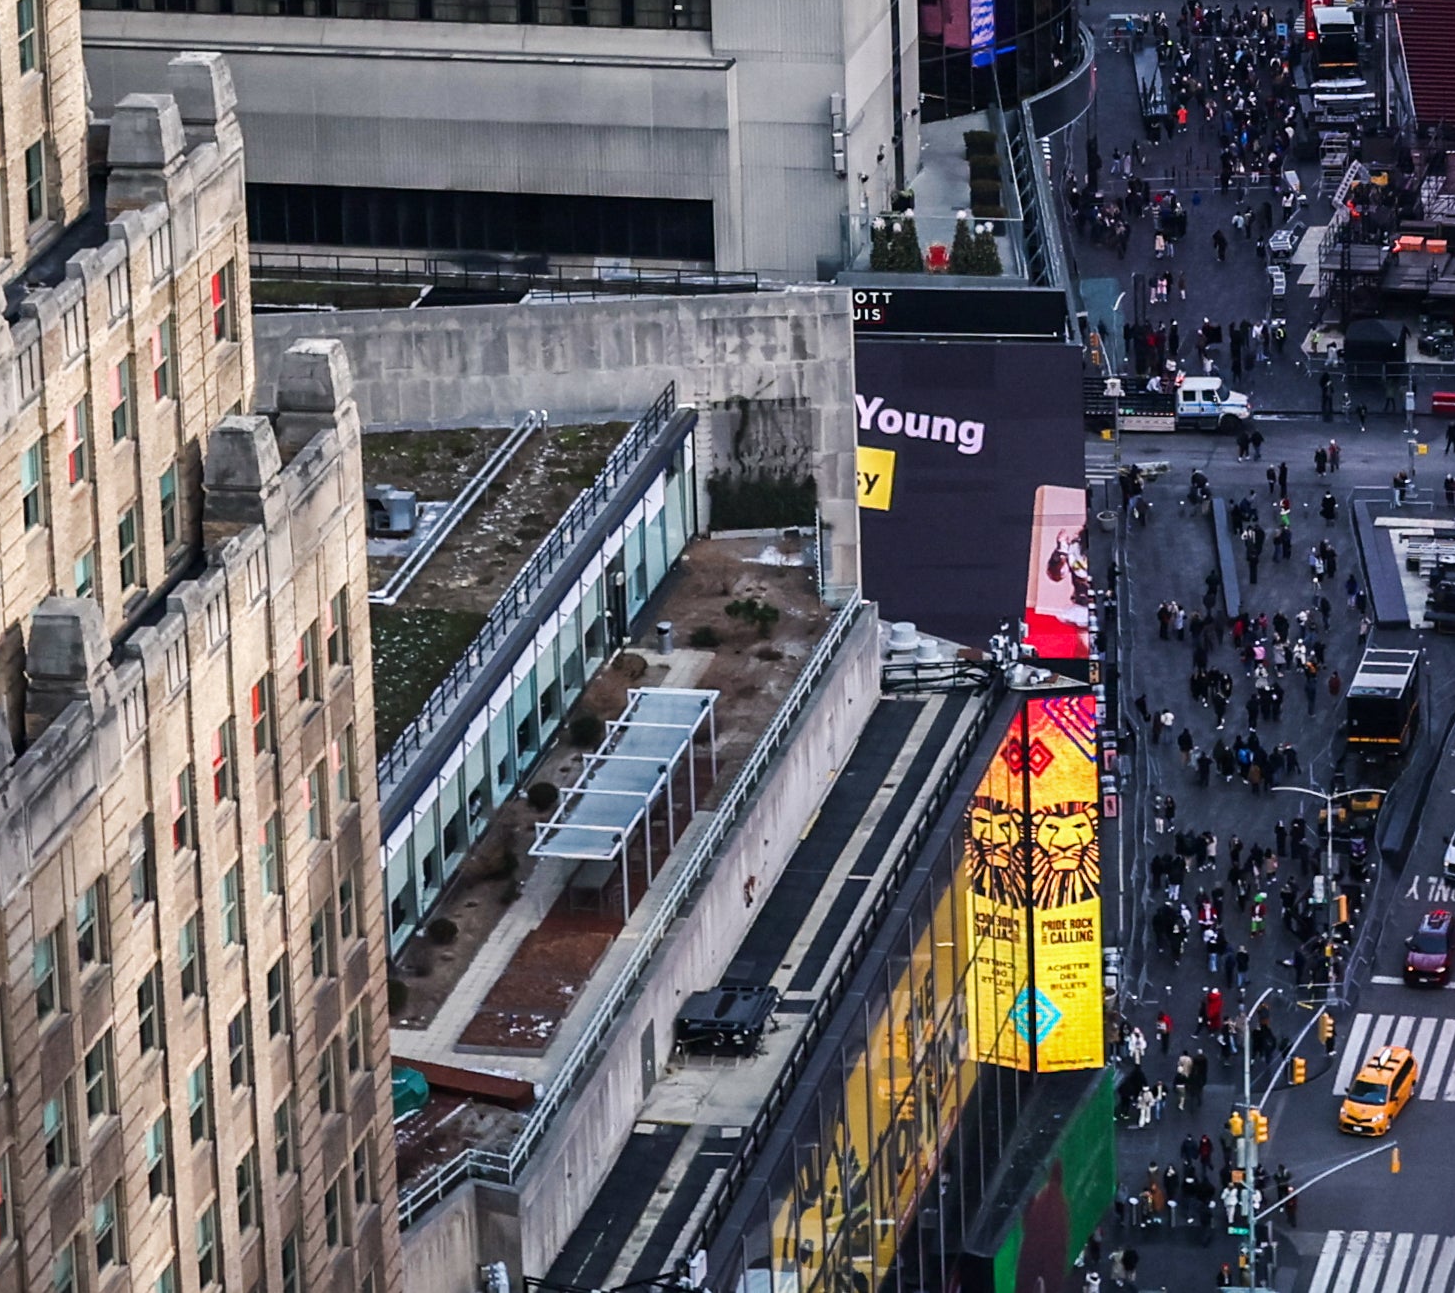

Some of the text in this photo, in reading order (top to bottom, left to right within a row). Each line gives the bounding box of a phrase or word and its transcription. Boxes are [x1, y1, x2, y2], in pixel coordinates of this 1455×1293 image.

[854, 291, 893, 305] OTT
[855, 393, 985, 455] Young
[1041, 917, 1093, 932] PRIDE ROCK
[1050, 930, 1094, 945] CALLING
[1046, 962, 1090, 972] ACHETER
[1059, 972, 1078, 981] DES
[1050, 982, 1088, 991] BILLETS
